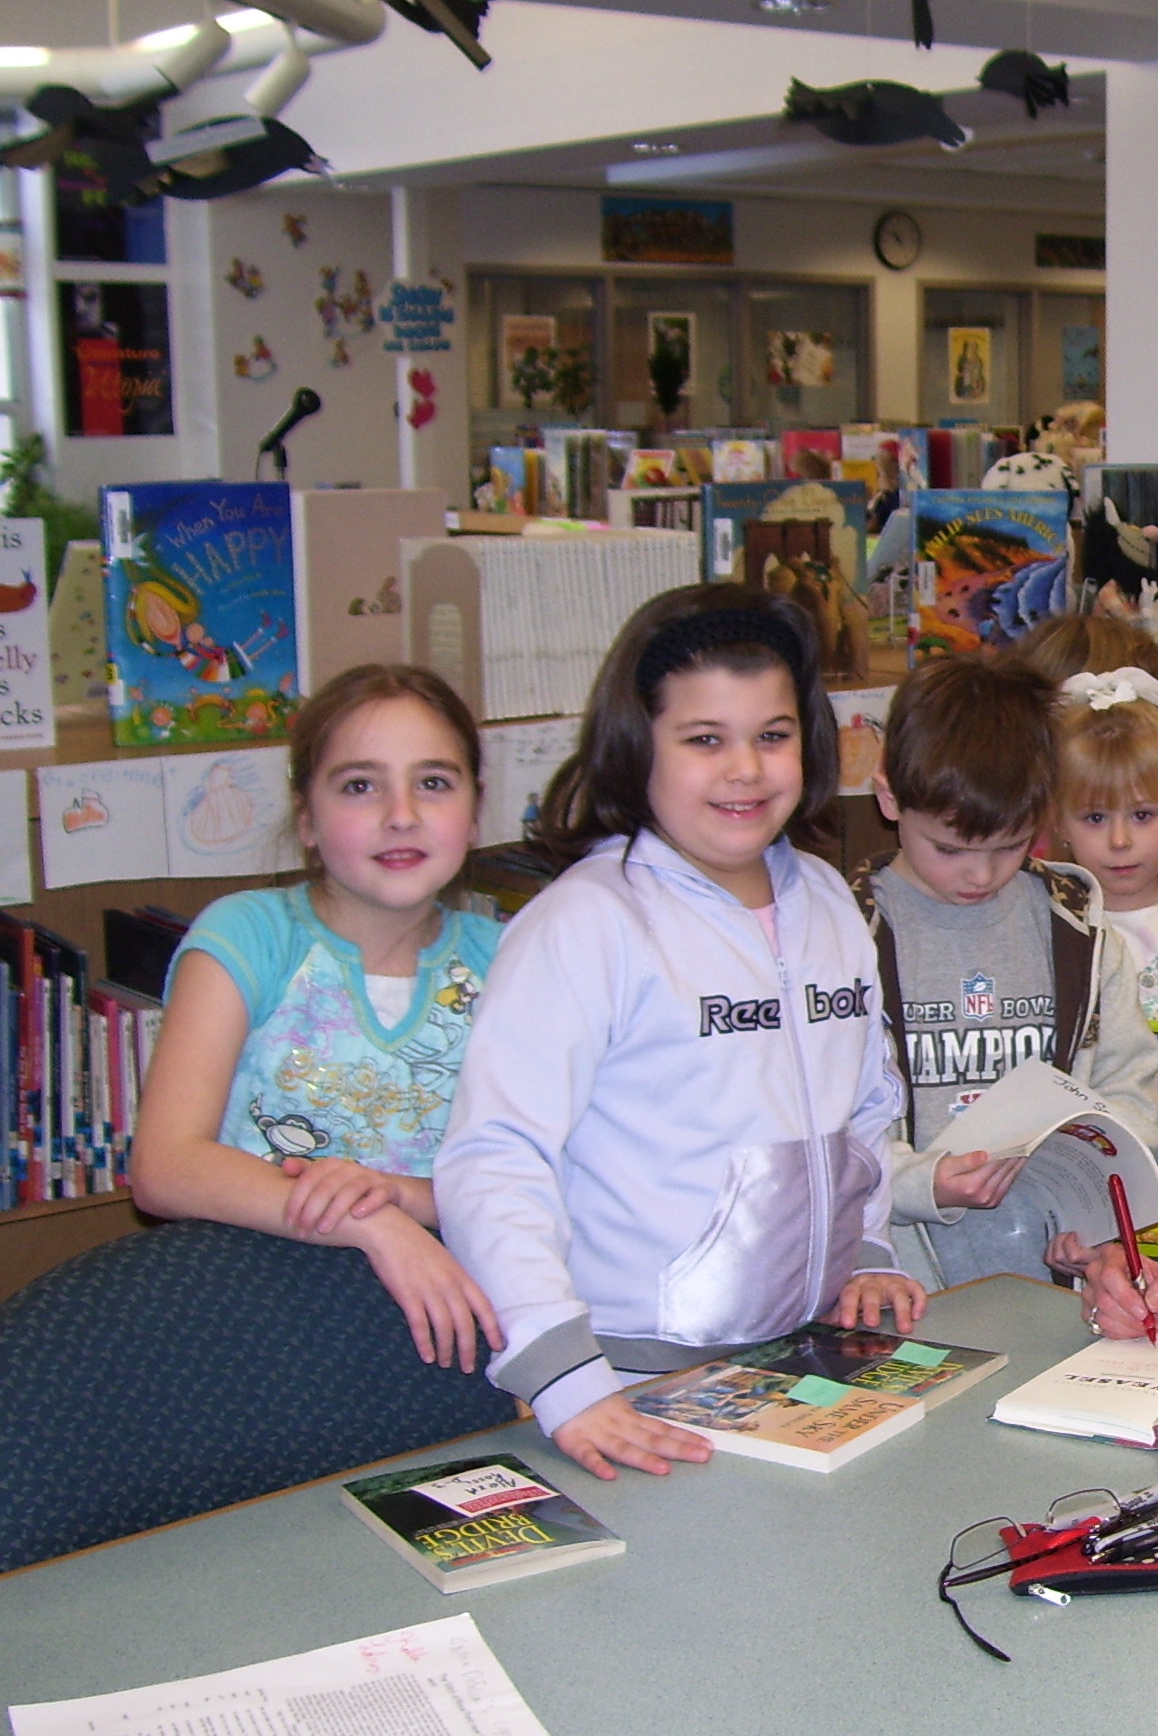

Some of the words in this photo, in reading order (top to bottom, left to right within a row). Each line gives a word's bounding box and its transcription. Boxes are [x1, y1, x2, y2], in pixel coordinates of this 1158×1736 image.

[164, 516, 215, 548] When
[209, 498, 245, 521] You
[171, 527, 289, 596] HAPPY
[902, 1001, 956, 1022] UPER
[966, 994, 994, 1016] NFL
[1001, 995, 1055, 1018] BOWL
[416, 1513, 534, 1549] BRIDGE
[433, 1524, 555, 1561] DEVIL'S
